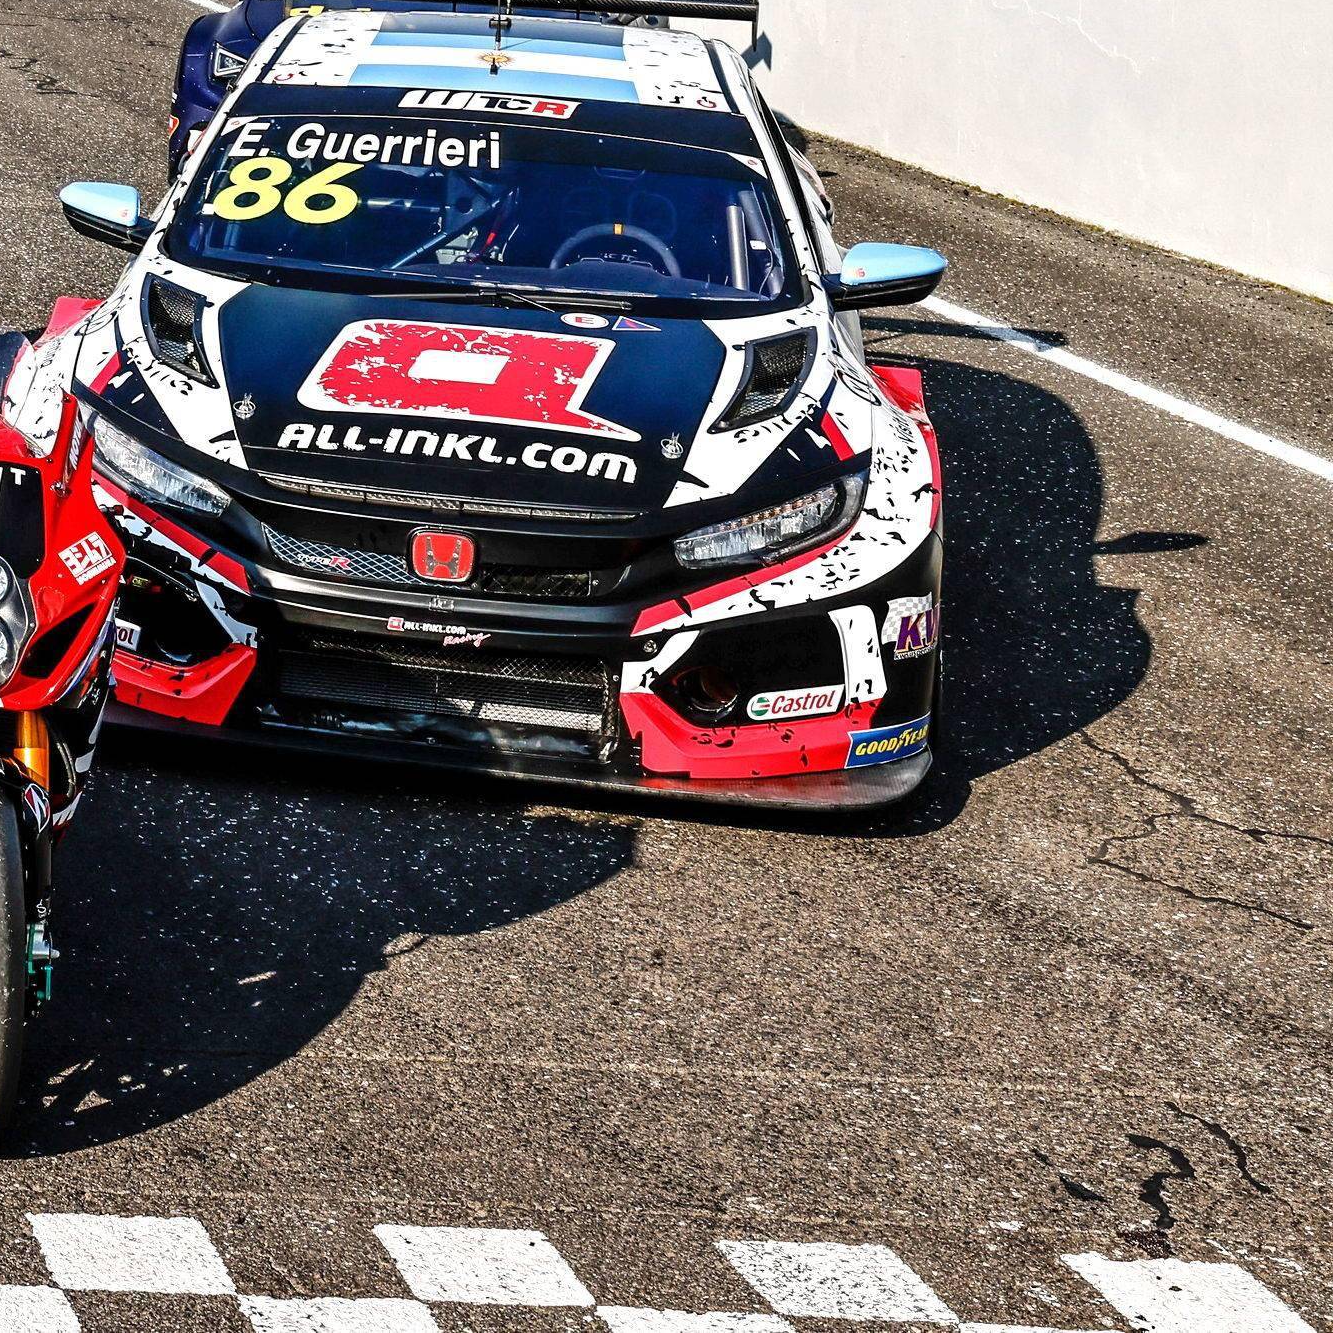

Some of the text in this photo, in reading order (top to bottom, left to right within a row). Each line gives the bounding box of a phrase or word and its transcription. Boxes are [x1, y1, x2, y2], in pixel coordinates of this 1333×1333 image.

[397, 90, 581, 120] WTCR
[229, 122, 501, 169] E. Guerrieri
[212, 156, 364, 225] 86
[10, 468, 28, 486] T
[771, 688, 837, 714] Castrol
[855, 724, 930, 757] GOODYEAR
